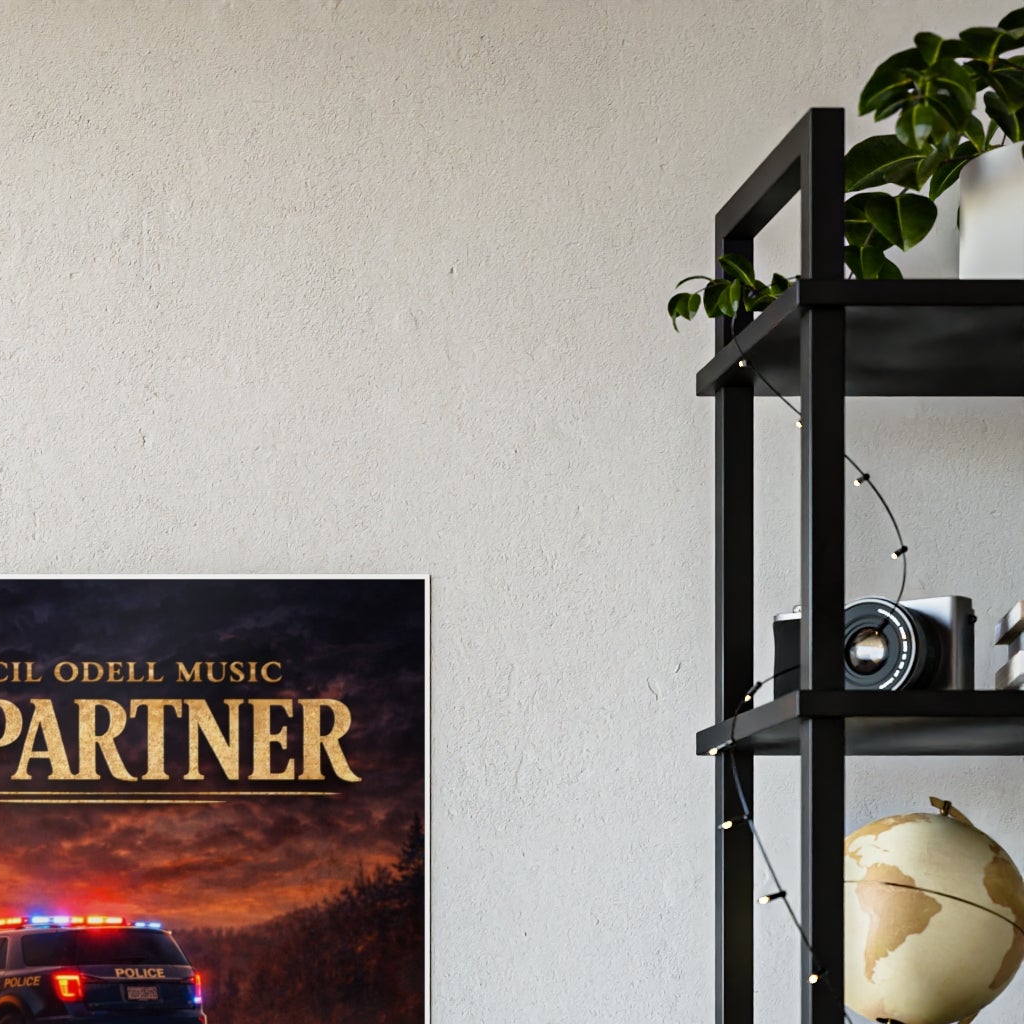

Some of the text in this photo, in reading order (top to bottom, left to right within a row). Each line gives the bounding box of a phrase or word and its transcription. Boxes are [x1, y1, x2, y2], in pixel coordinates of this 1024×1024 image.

[53, 661, 164, 683] ODELL
[176, 661, 283, 683] MUSIC
[114, 968, 166, 979] POLICE
[3, 975, 42, 989] POLICE
